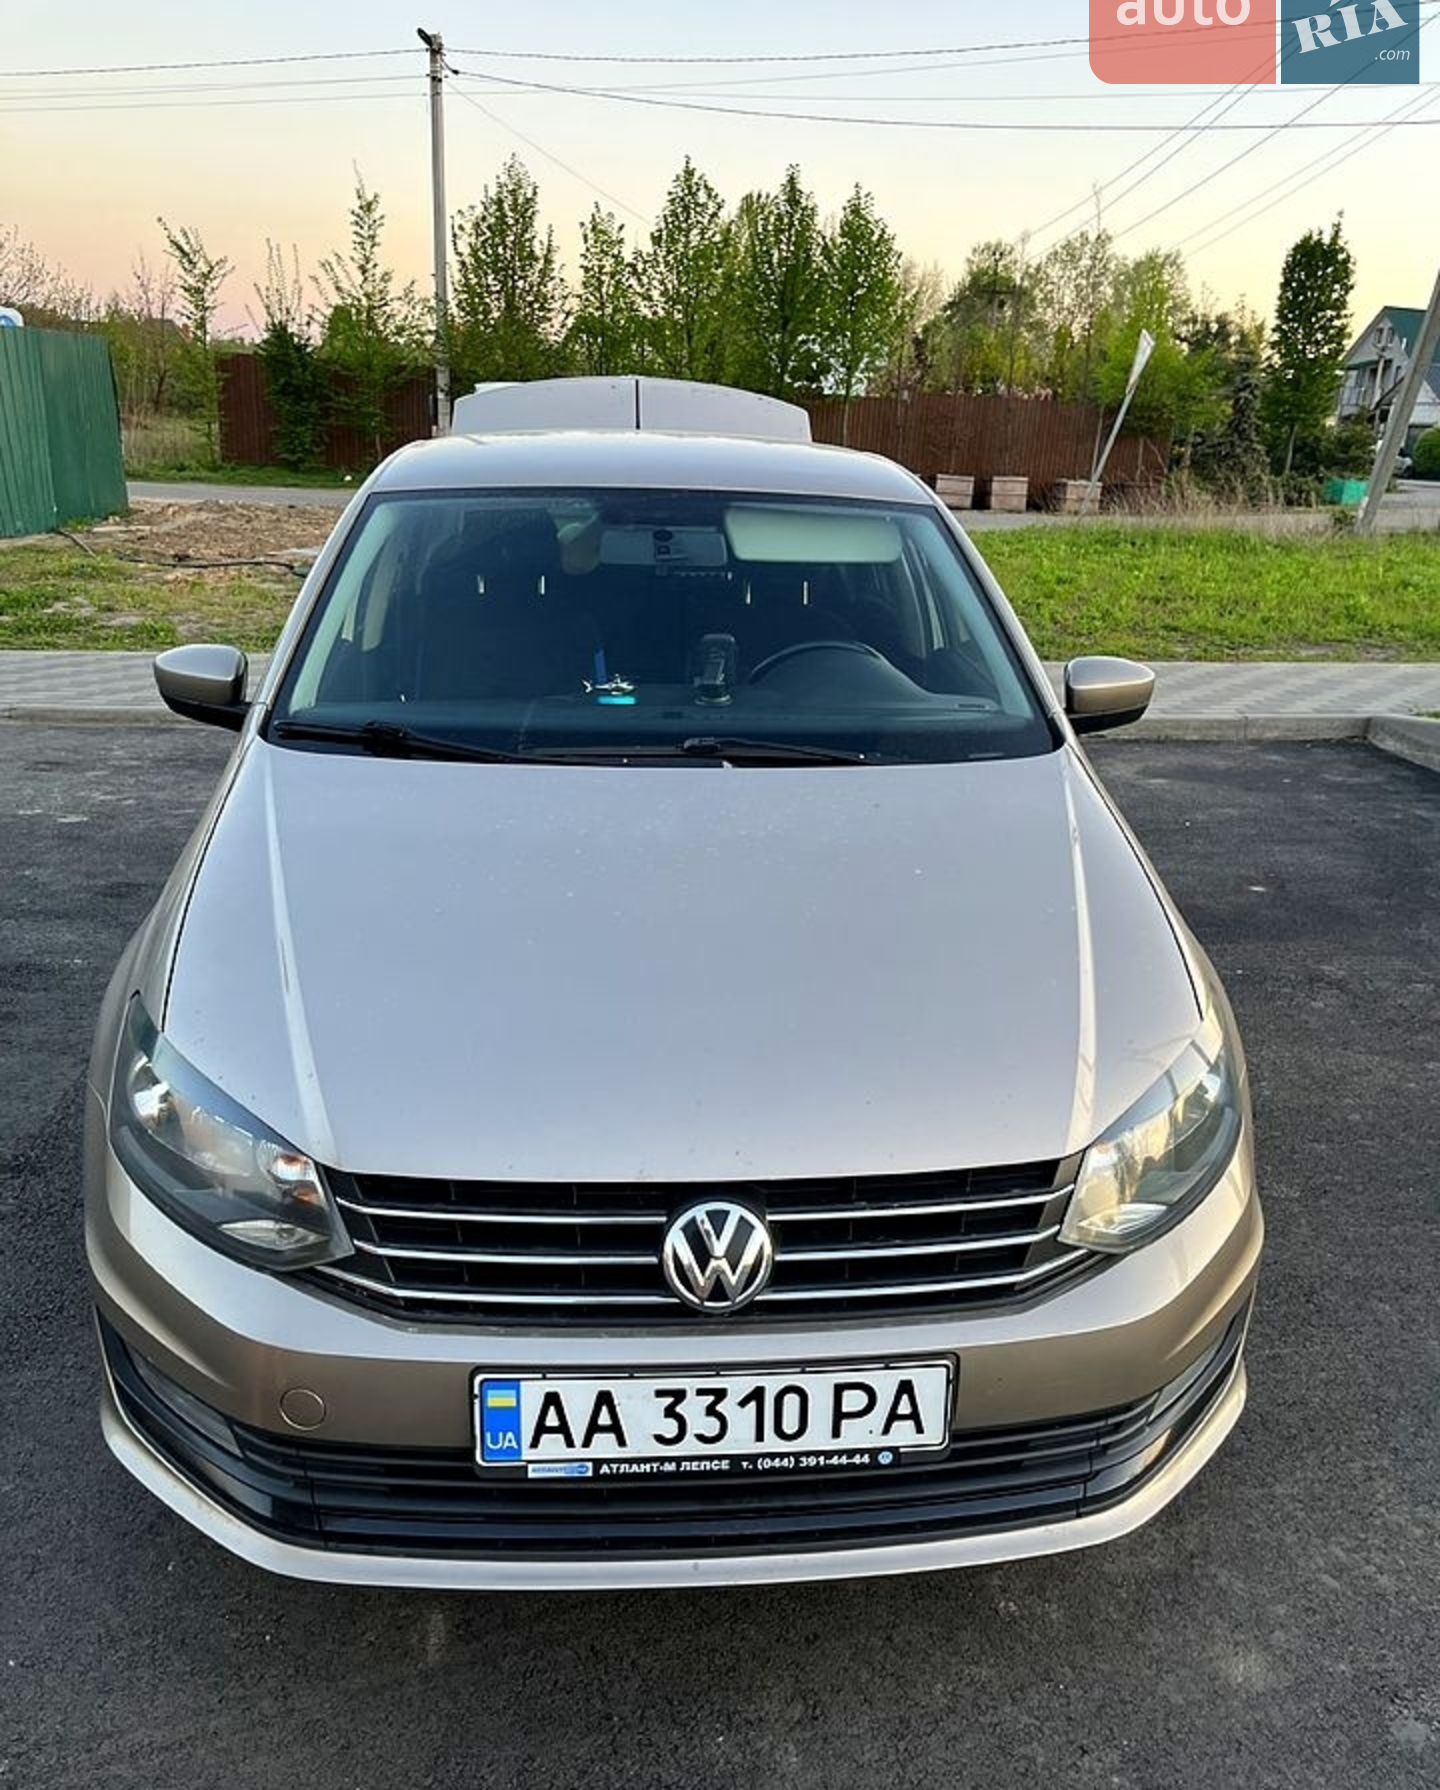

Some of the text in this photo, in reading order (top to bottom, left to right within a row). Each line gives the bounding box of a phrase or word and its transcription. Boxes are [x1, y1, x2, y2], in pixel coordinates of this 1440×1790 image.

[529, 1379, 925, 1449] AA 3310 PA
[486, 1431, 518, 1449] UA
[757, 1456, 795, 1470] (044)
[799, 1453, 871, 1467] 391-44-44
